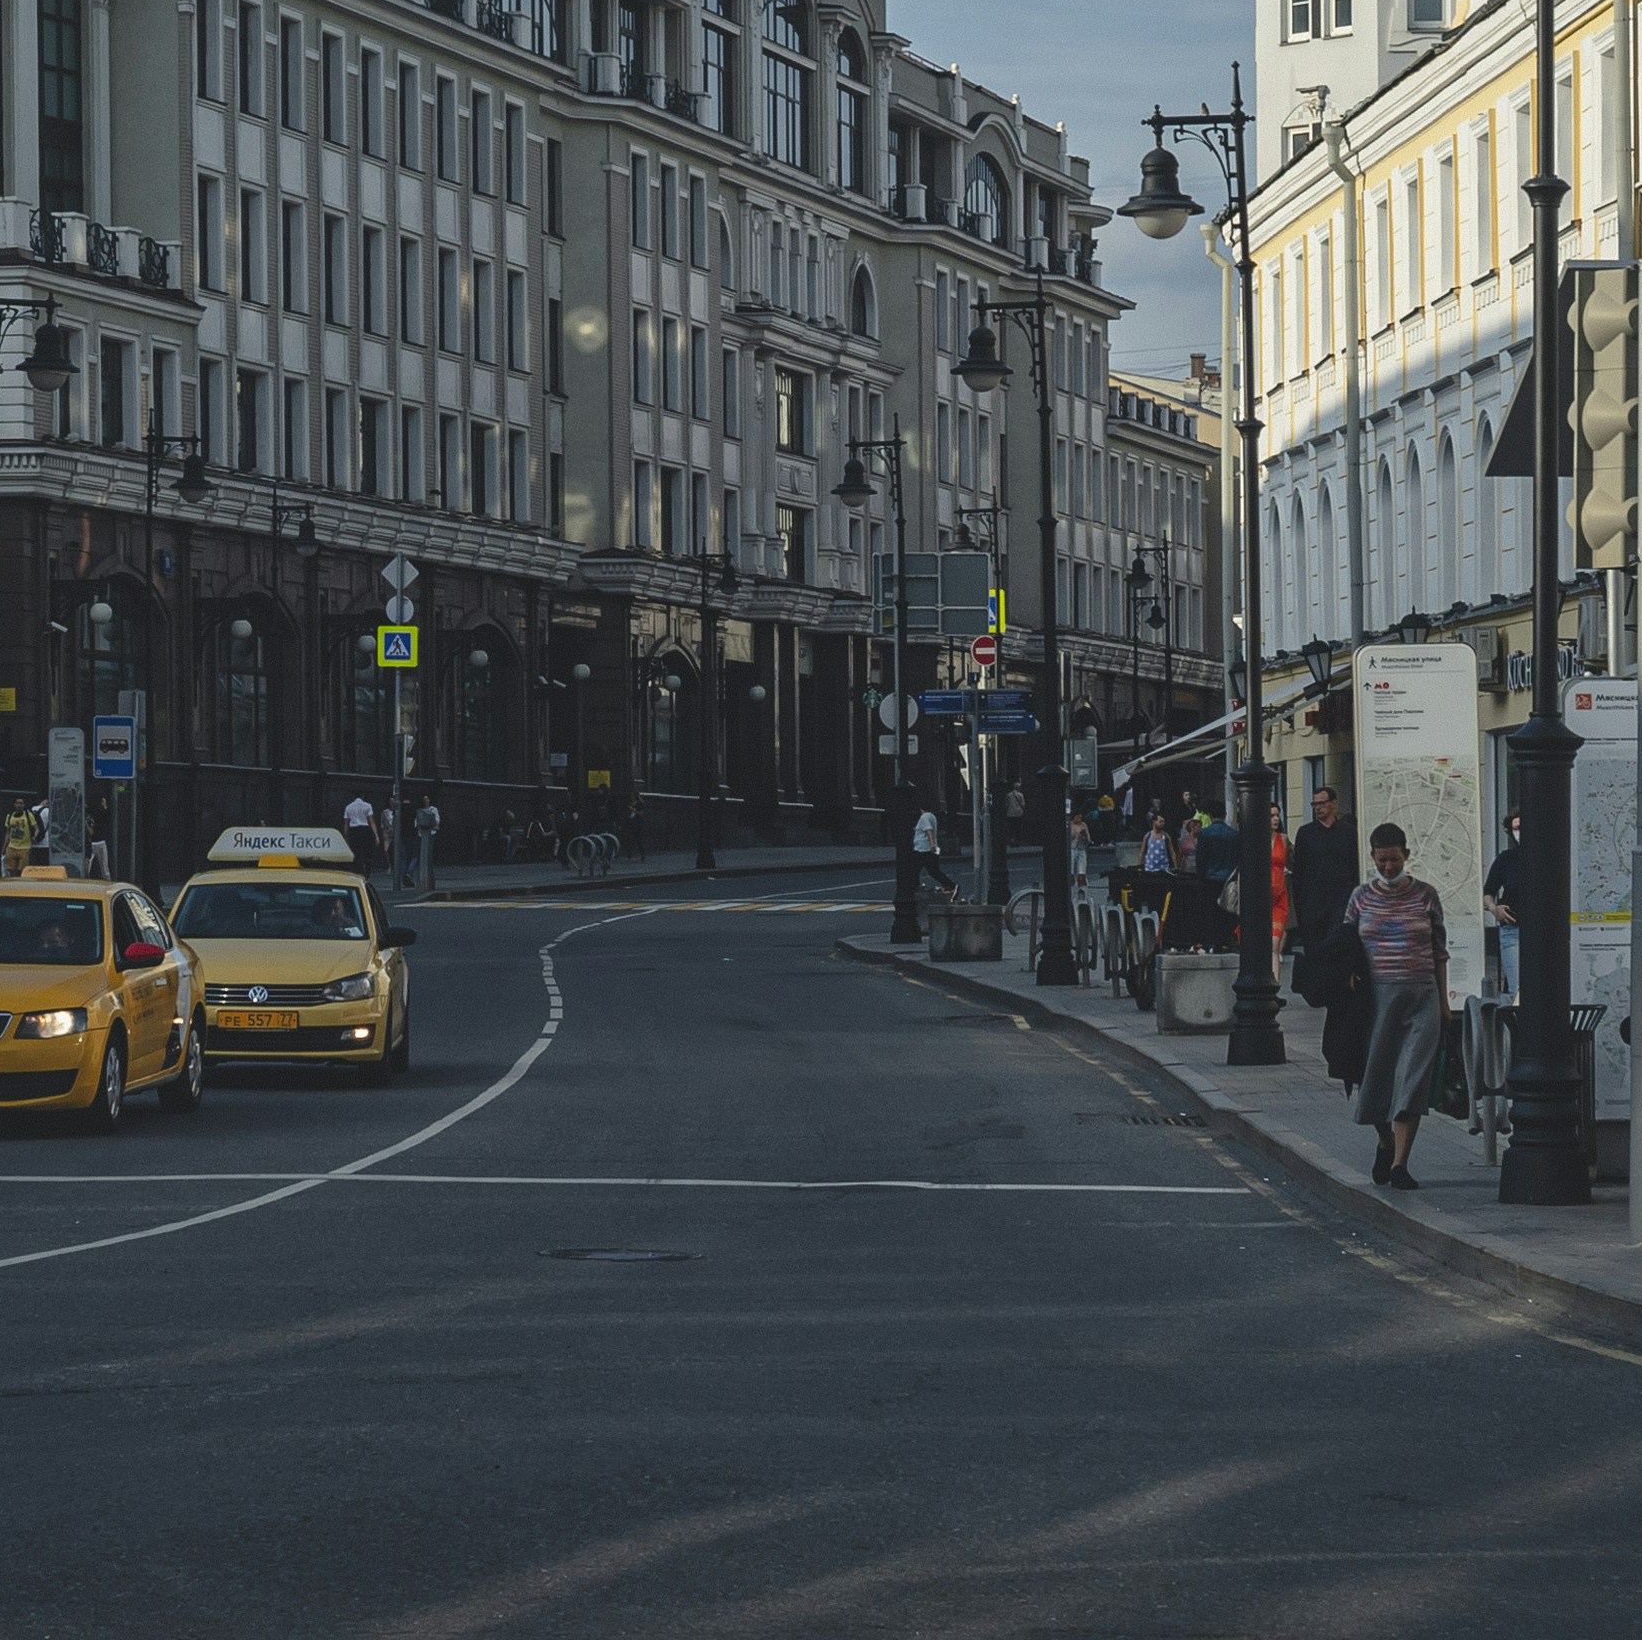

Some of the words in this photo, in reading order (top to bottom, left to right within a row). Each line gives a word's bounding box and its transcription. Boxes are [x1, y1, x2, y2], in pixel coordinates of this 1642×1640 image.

[1596, 693, 1638, 702] Мясницка
[233, 832, 285, 849] Яндекс
[289, 833, 331, 849] Такси
[224, 1015, 242, 1027] РЕ
[247, 1013, 273, 1027] 557
[279, 1012, 294, 1024] 77
